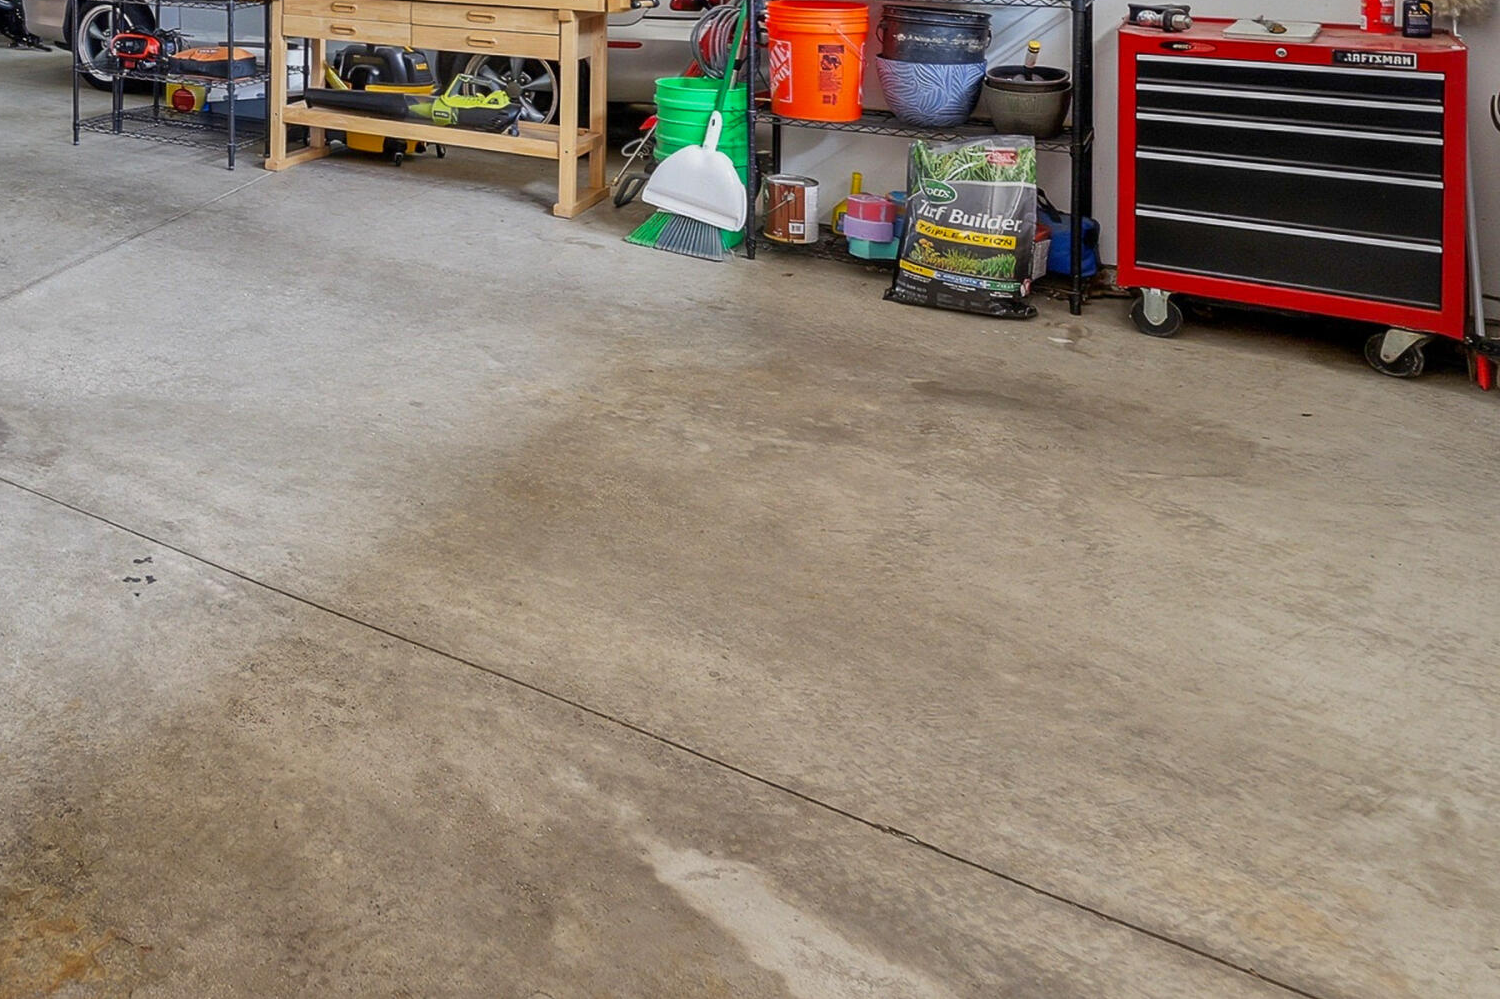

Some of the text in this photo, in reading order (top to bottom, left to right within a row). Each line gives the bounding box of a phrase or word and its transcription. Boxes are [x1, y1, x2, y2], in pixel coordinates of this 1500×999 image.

[917, 199, 1023, 232] Turf Builder
[919, 223, 1013, 247] TRIPLE ACTION
